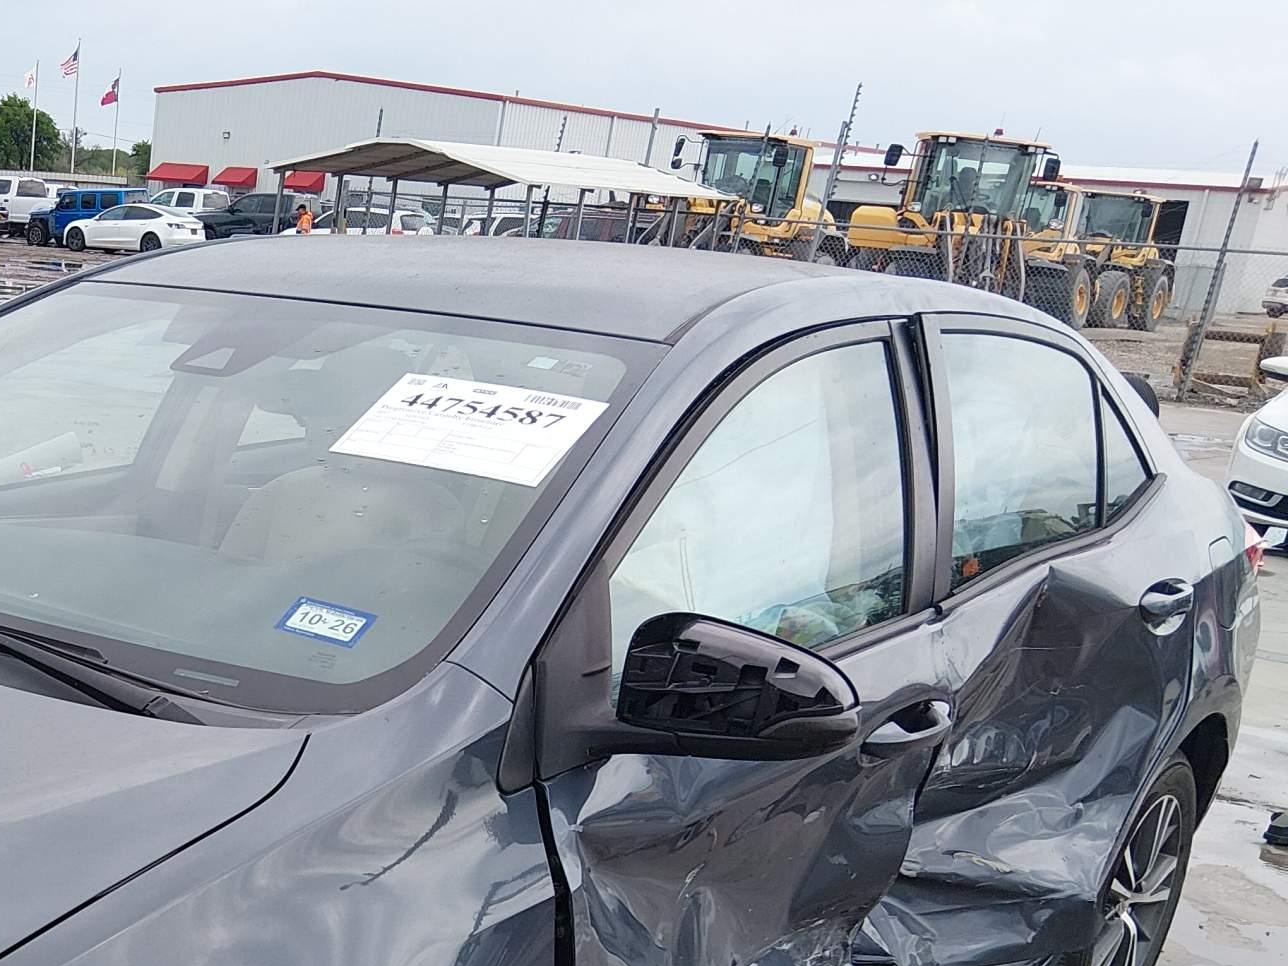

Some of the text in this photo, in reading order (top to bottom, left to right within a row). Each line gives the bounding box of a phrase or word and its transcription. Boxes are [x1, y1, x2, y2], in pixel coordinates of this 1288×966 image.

[401, 393, 566, 428] 44754587
[299, 611, 323, 625] 10
[328, 619, 358, 634] 26
